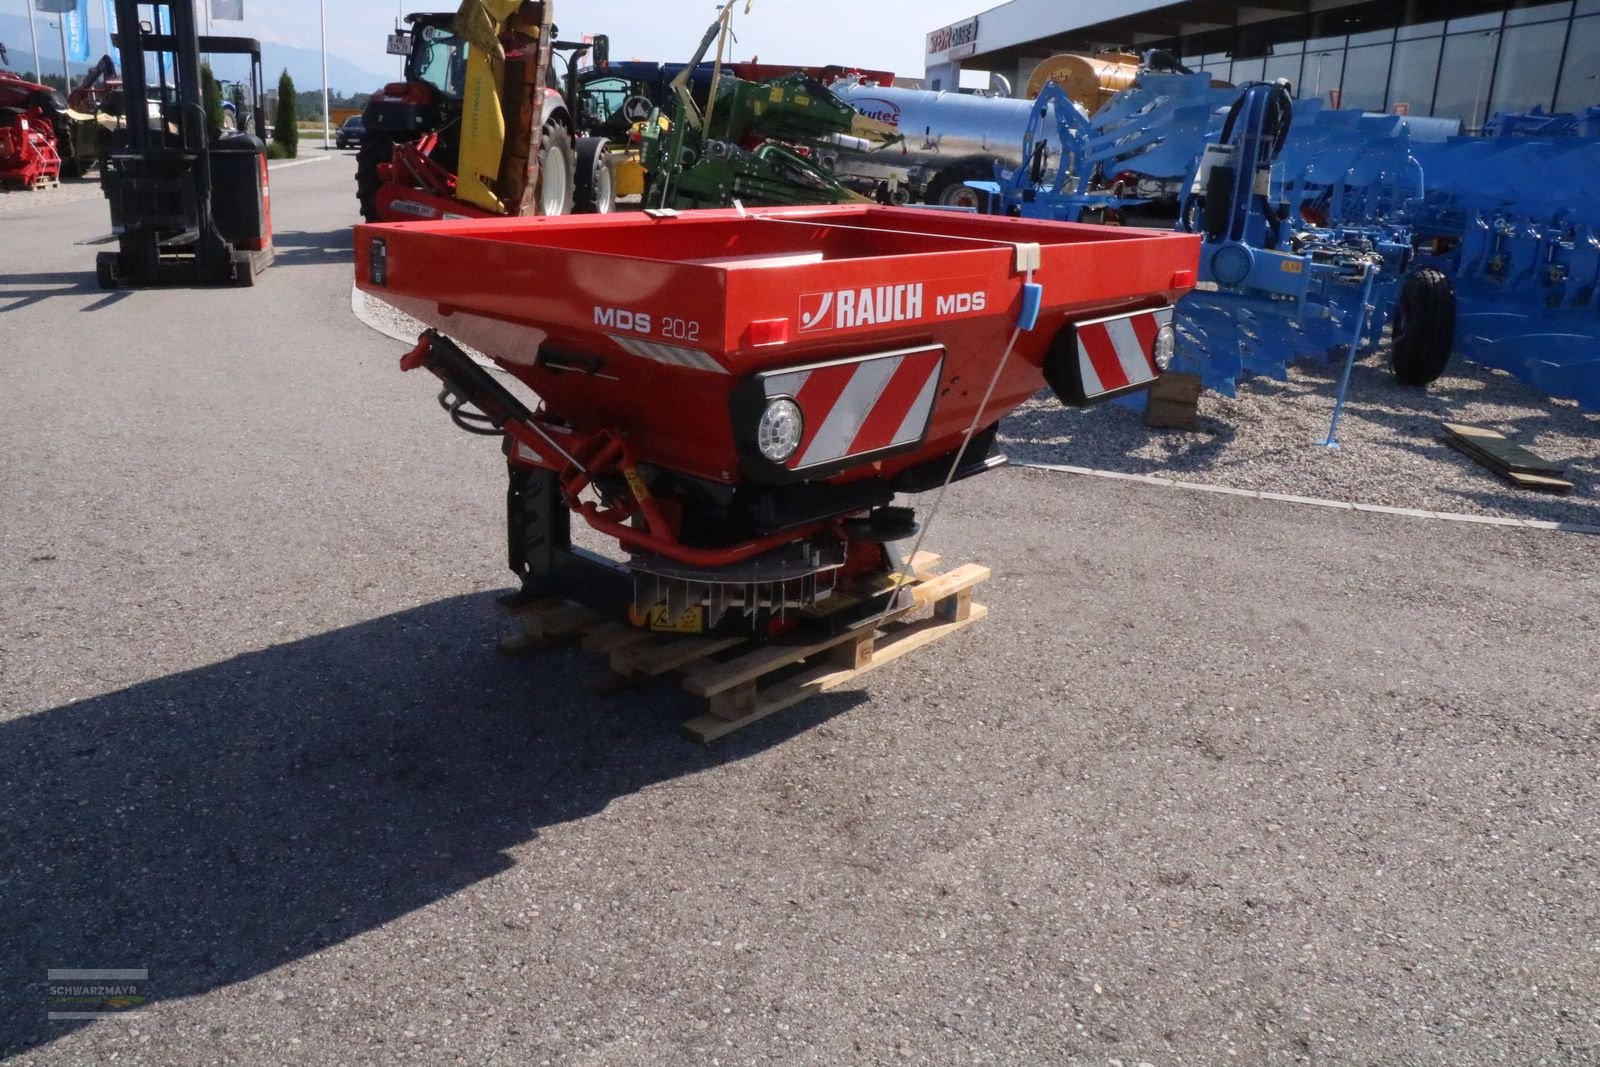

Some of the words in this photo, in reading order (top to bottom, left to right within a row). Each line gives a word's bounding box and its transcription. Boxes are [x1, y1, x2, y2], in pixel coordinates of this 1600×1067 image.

[593, 305, 652, 334] MDS
[661, 316, 700, 342] 20.2
[836, 282, 923, 330] RAUCH
[935, 291, 986, 316] MDS
